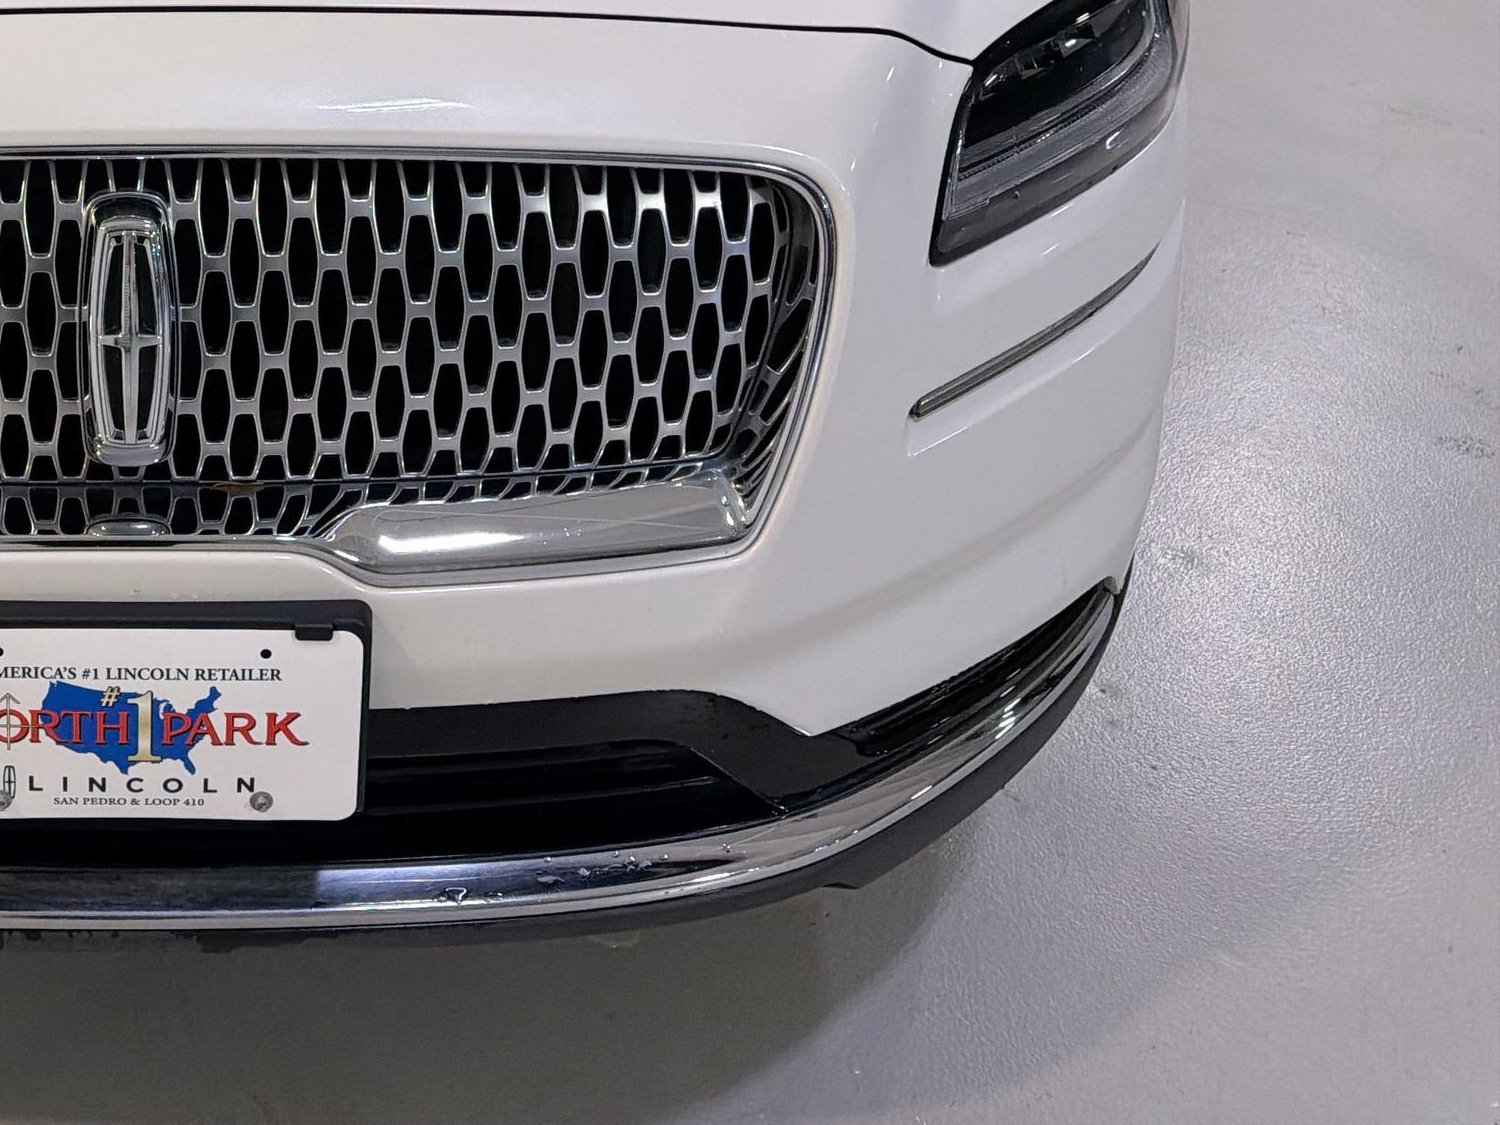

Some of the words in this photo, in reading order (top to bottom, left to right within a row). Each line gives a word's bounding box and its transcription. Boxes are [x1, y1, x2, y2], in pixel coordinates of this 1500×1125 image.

[81, 668, 99, 680] #1
[105, 667, 190, 681] LINCOLN
[194, 668, 283, 682] RETAILER
[163, 711, 310, 746] PARK
[28, 775, 256, 794] LINCOLN
[53, 796, 79, 806] SAN
[82, 797, 127, 806] PEDRO
[130, 797, 141, 806] &
[144, 797, 181, 807] LOOP
[183, 798, 205, 807] 410
